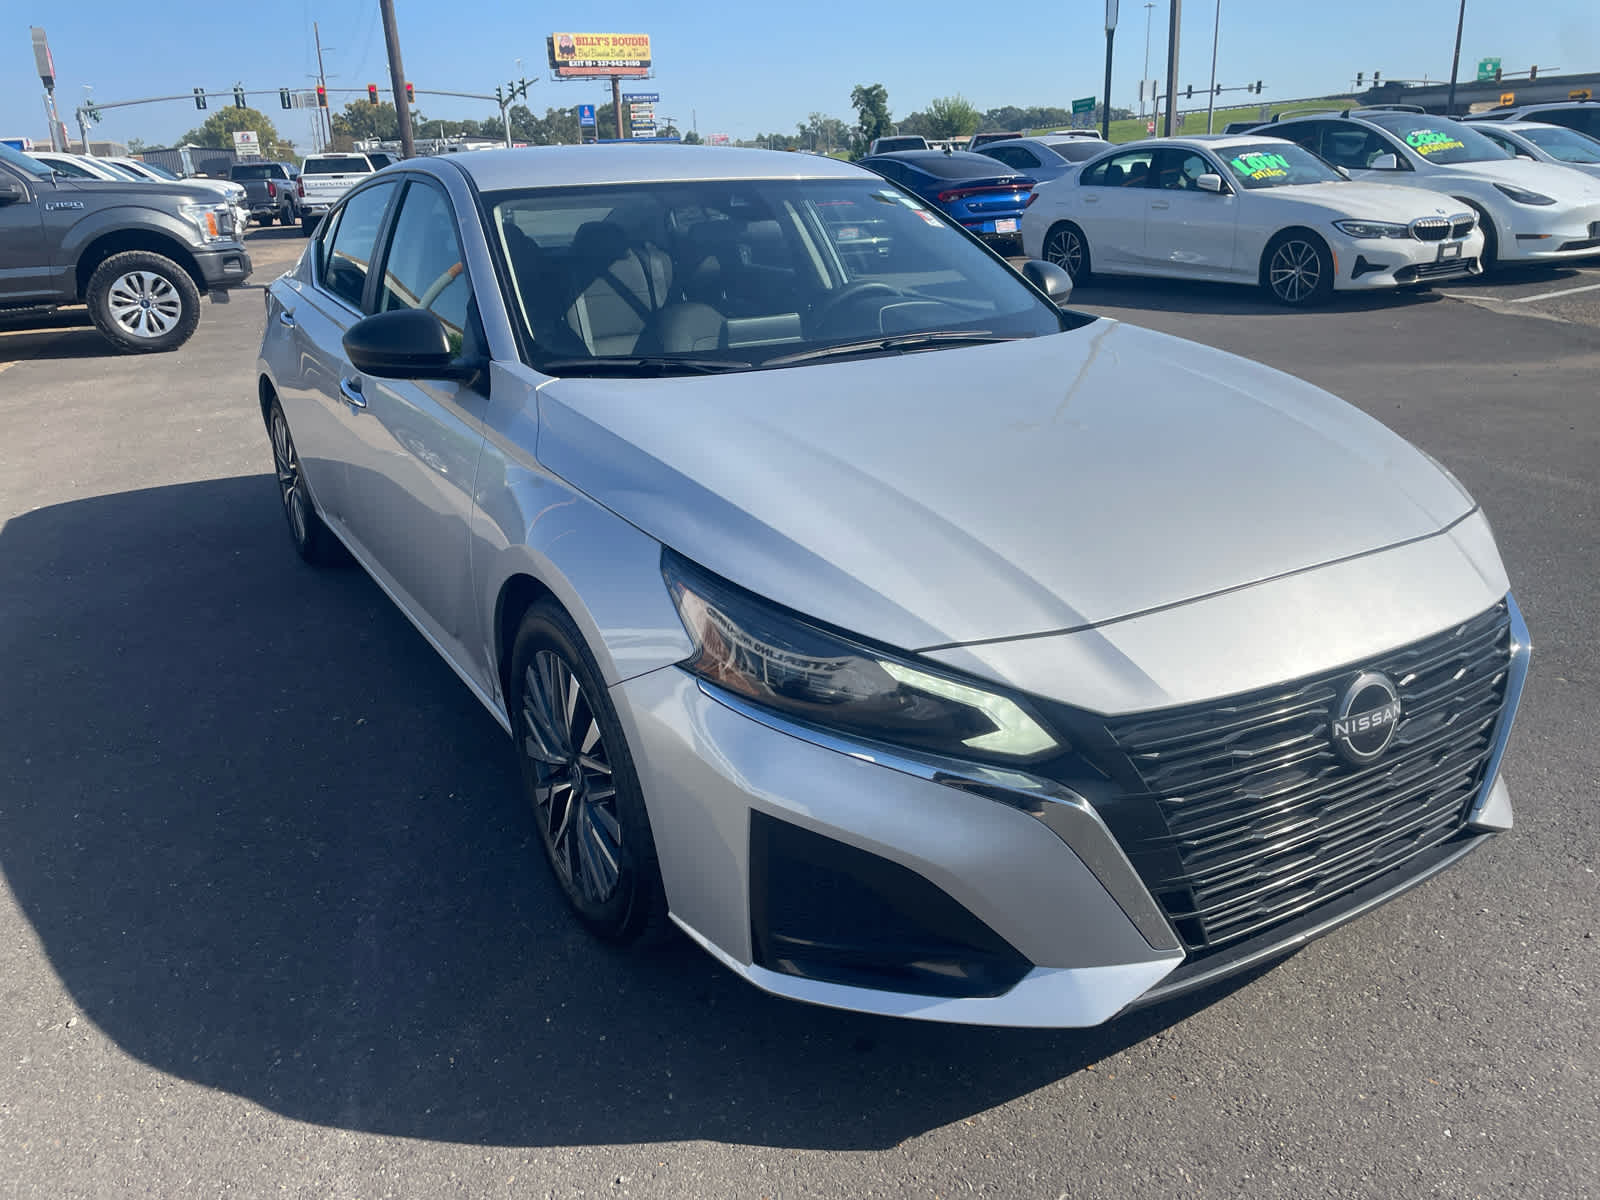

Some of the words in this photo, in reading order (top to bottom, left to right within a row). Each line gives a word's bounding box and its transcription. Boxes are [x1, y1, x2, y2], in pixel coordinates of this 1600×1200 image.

[576, 36, 610, 46] BILLY'S
[612, 37, 649, 46] BOUDIN
[1231, 154, 1290, 177] LOW
[1334, 700, 1401, 737] NISSAN
